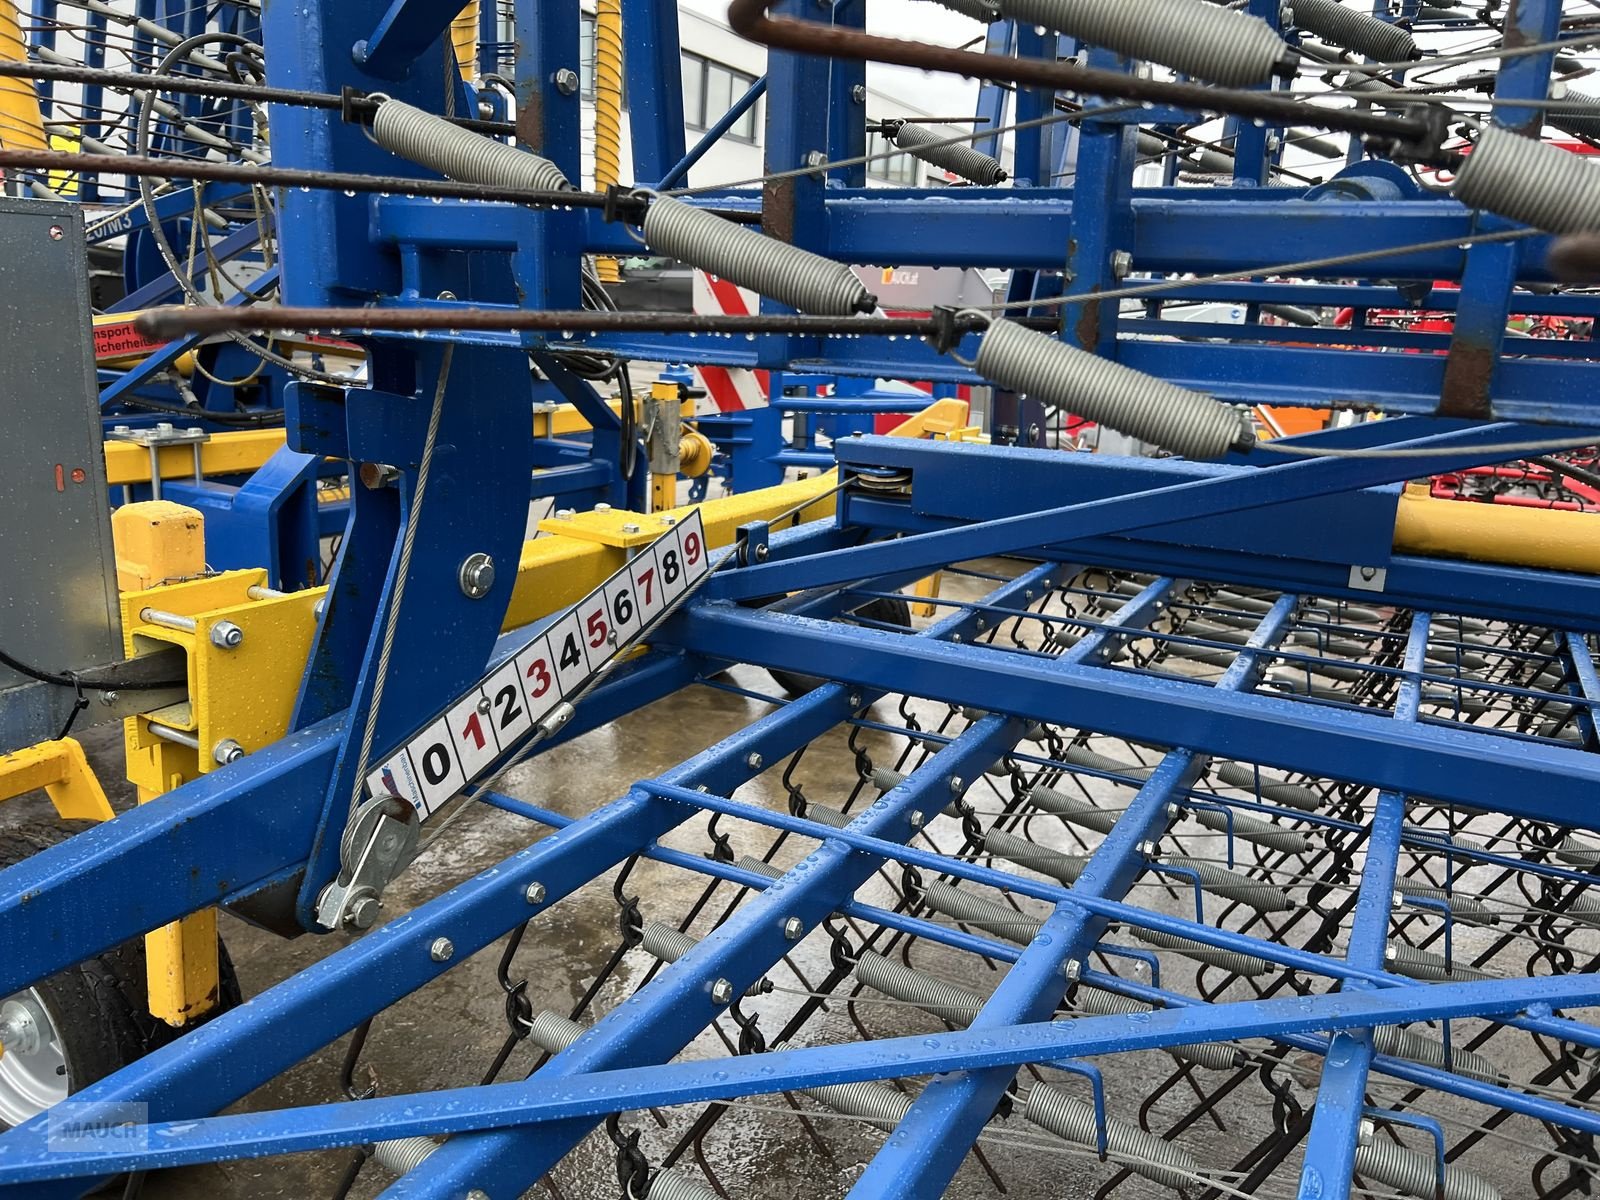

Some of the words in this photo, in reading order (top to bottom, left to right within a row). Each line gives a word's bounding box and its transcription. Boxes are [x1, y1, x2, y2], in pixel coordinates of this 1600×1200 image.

[422, 742, 451, 786] 0
[462, 712, 486, 751] 1
[494, 685, 522, 730] 2
[526, 658, 551, 698] 3
[560, 632, 581, 671] 4
[587, 609, 608, 649] 5
[613, 589, 633, 625] 6
[637, 568, 654, 606] 7
[663, 550, 679, 584] 8
[684, 532, 700, 566] 9
[399, 753, 420, 803] Maschinenbau
